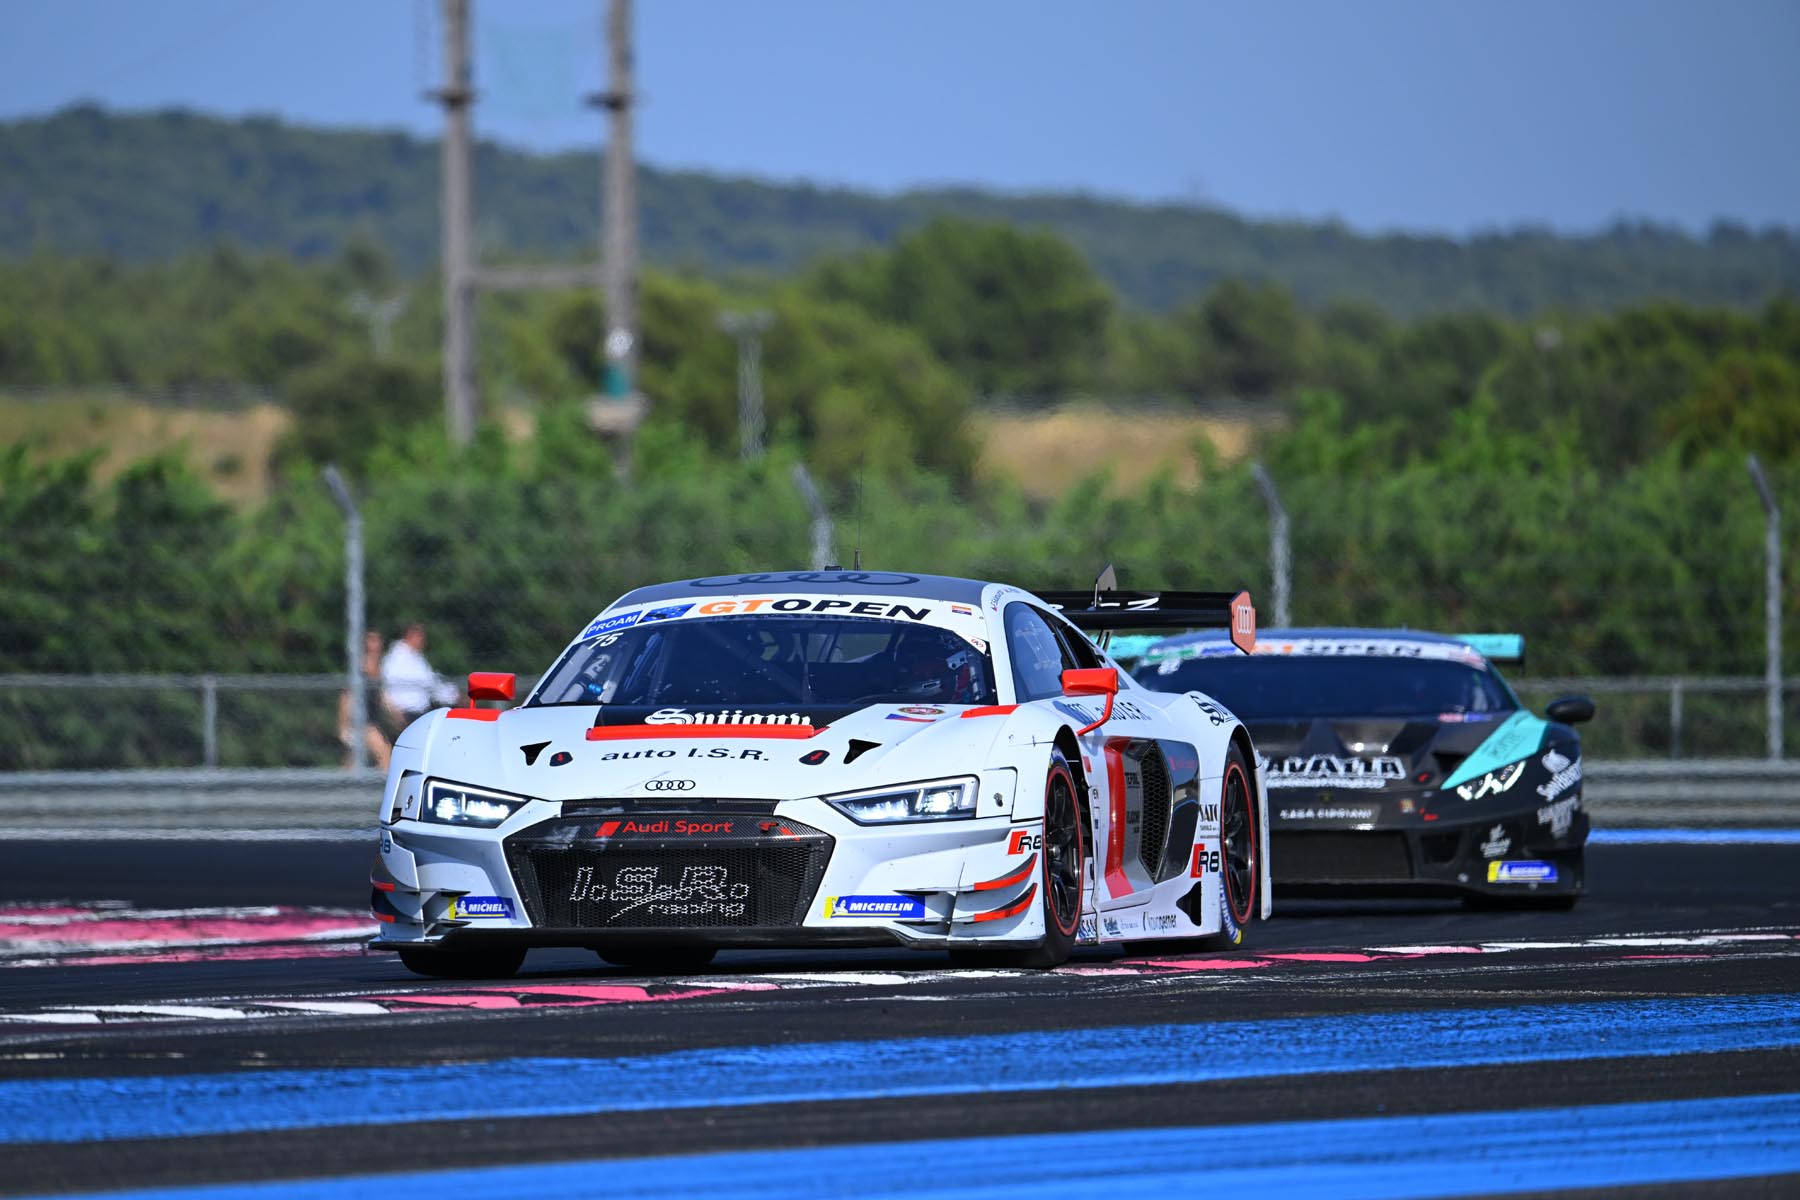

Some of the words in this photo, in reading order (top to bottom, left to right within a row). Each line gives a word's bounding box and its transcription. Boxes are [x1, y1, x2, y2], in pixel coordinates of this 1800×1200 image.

[587, 615, 638, 634] PROAM
[588, 632, 624, 649] 75
[601, 749, 677, 761] auto
[687, 748, 769, 762] I.S.R.
[622, 820, 669, 833] Audi
[674, 820, 734, 836] Sport
[1198, 850, 1220, 873] R8
[849, 902, 914, 912] MICHELIN
